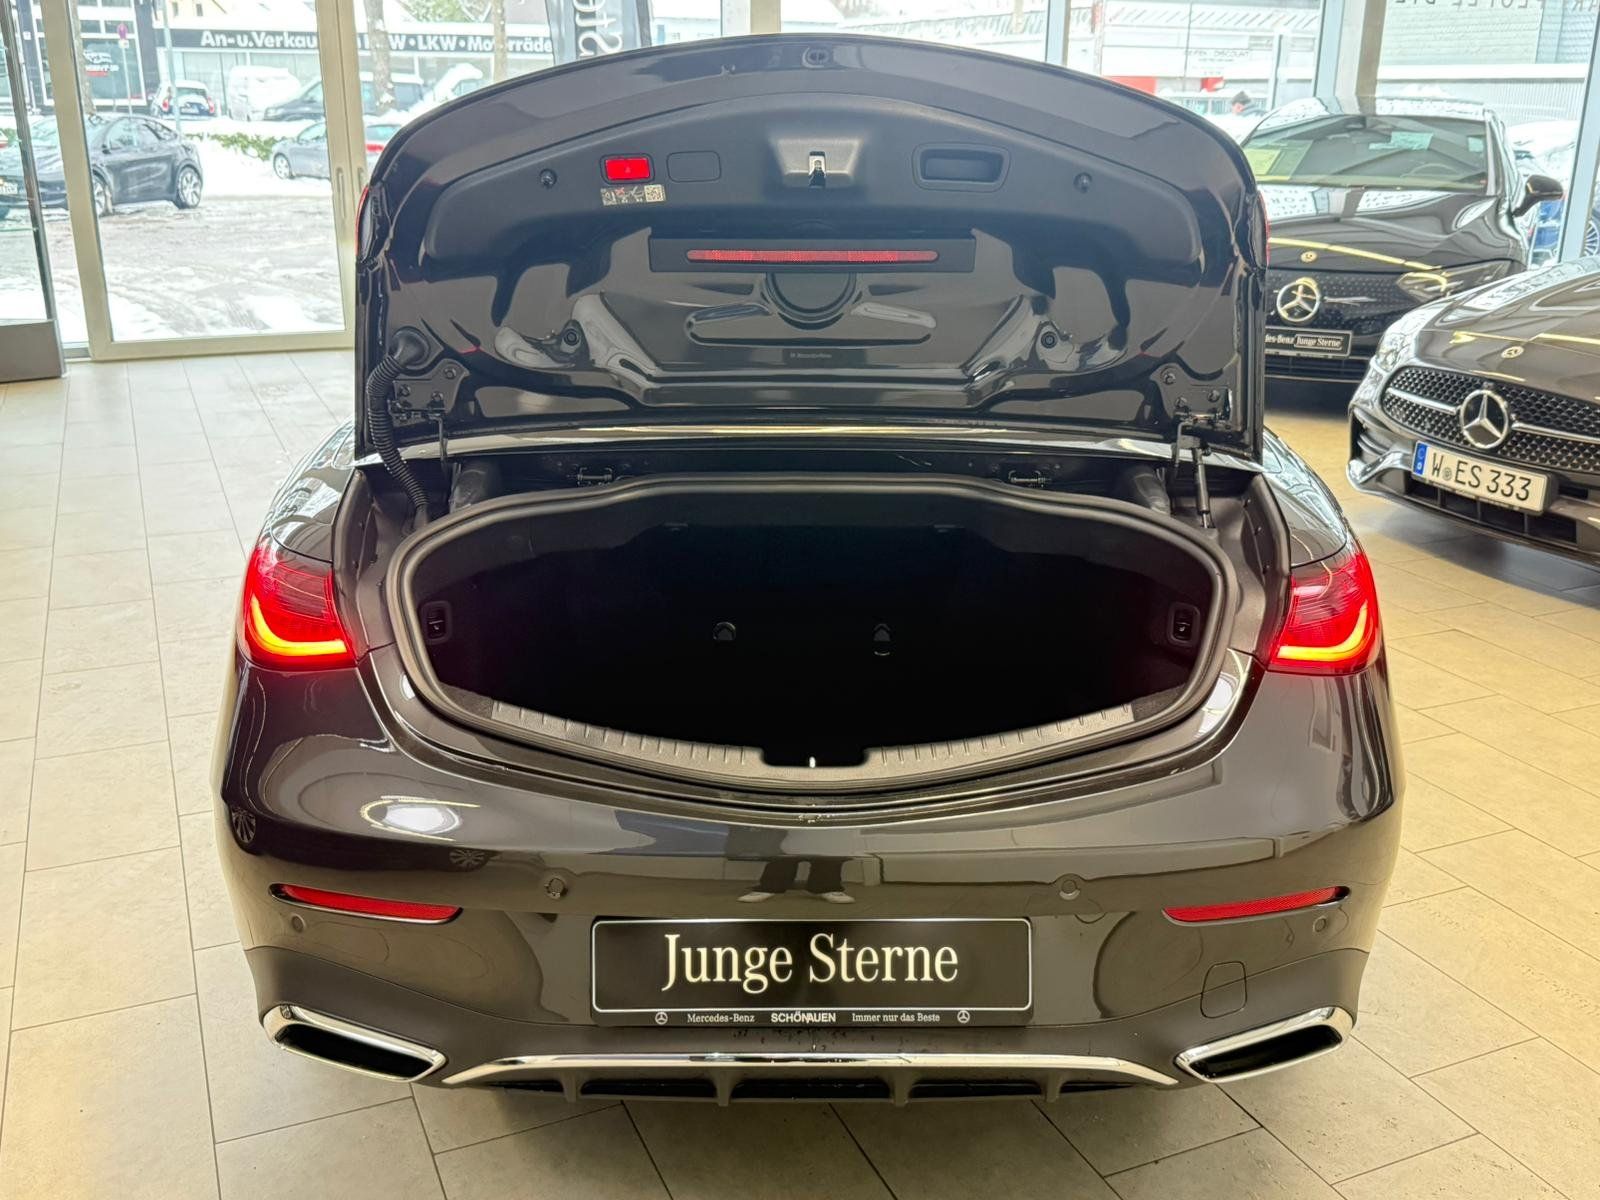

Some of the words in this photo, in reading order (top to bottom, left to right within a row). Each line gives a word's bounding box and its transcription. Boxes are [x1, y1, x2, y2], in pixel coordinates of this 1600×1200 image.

[418, 34, 457, 51] LKW
[467, 35, 553, 52] Morräde
[1431, 452, 1444, 477] W
[1455, 460, 1482, 488] ES
[1487, 469, 1532, 502] 333
[661, 933, 793, 994] Junge
[809, 932, 959, 983] Sterne
[687, 1013, 755, 1023] Mercedes-Benz
[770, 1010, 836, 1023] SCHÖNAUEN
[852, 1012, 881, 1022] Immer
[882, 1014, 899, 1022] nur
[900, 1012, 916, 1022] das
[917, 1012, 940, 1022] Beste
